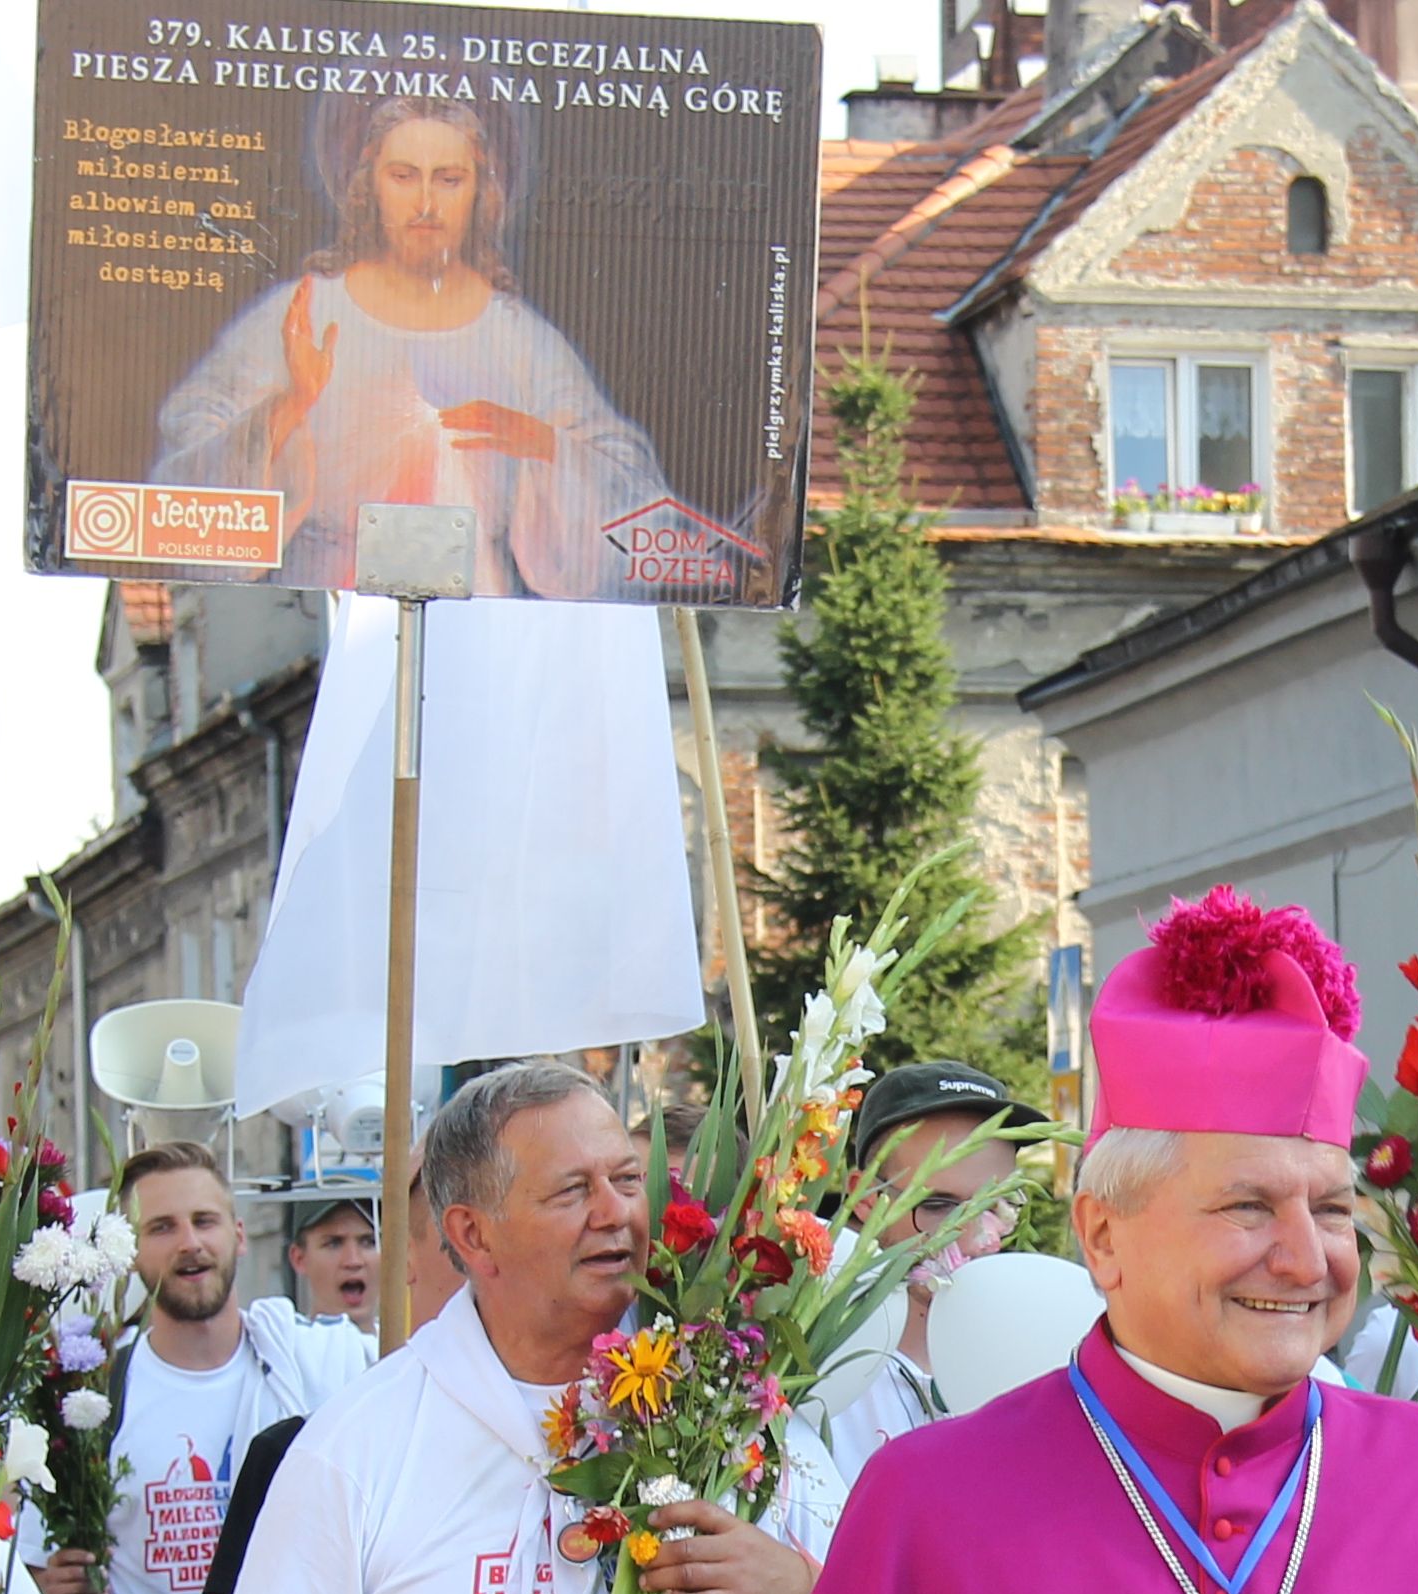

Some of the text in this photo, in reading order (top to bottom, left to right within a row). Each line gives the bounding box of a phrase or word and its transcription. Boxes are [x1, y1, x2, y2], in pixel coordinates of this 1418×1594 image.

[147, 20, 711, 75] 379. KALISKA 25. DIECEZJALNA
[72, 52, 785, 123] PIESZA PIELGRZYMKA NA JASNĄ GÓRĘ
[62, 119, 267, 152] Błogosławieni
[76, 156, 240, 187] miłosierni,
[69, 191, 257, 221] albowiem oni
[67, 225, 258, 255] miłosierdzia
[99, 262, 226, 293] dostąpią
[763, 244, 791, 461] pielgrzymka-kaliska.pl
[151, 493, 270, 539] Jedynka
[157, 541, 263, 560] POLSKIE RADIO
[631, 527, 709, 555] DOM
[623, 551, 737, 587] JÓZEFA
[938, 1080, 997, 1099] Supreme
